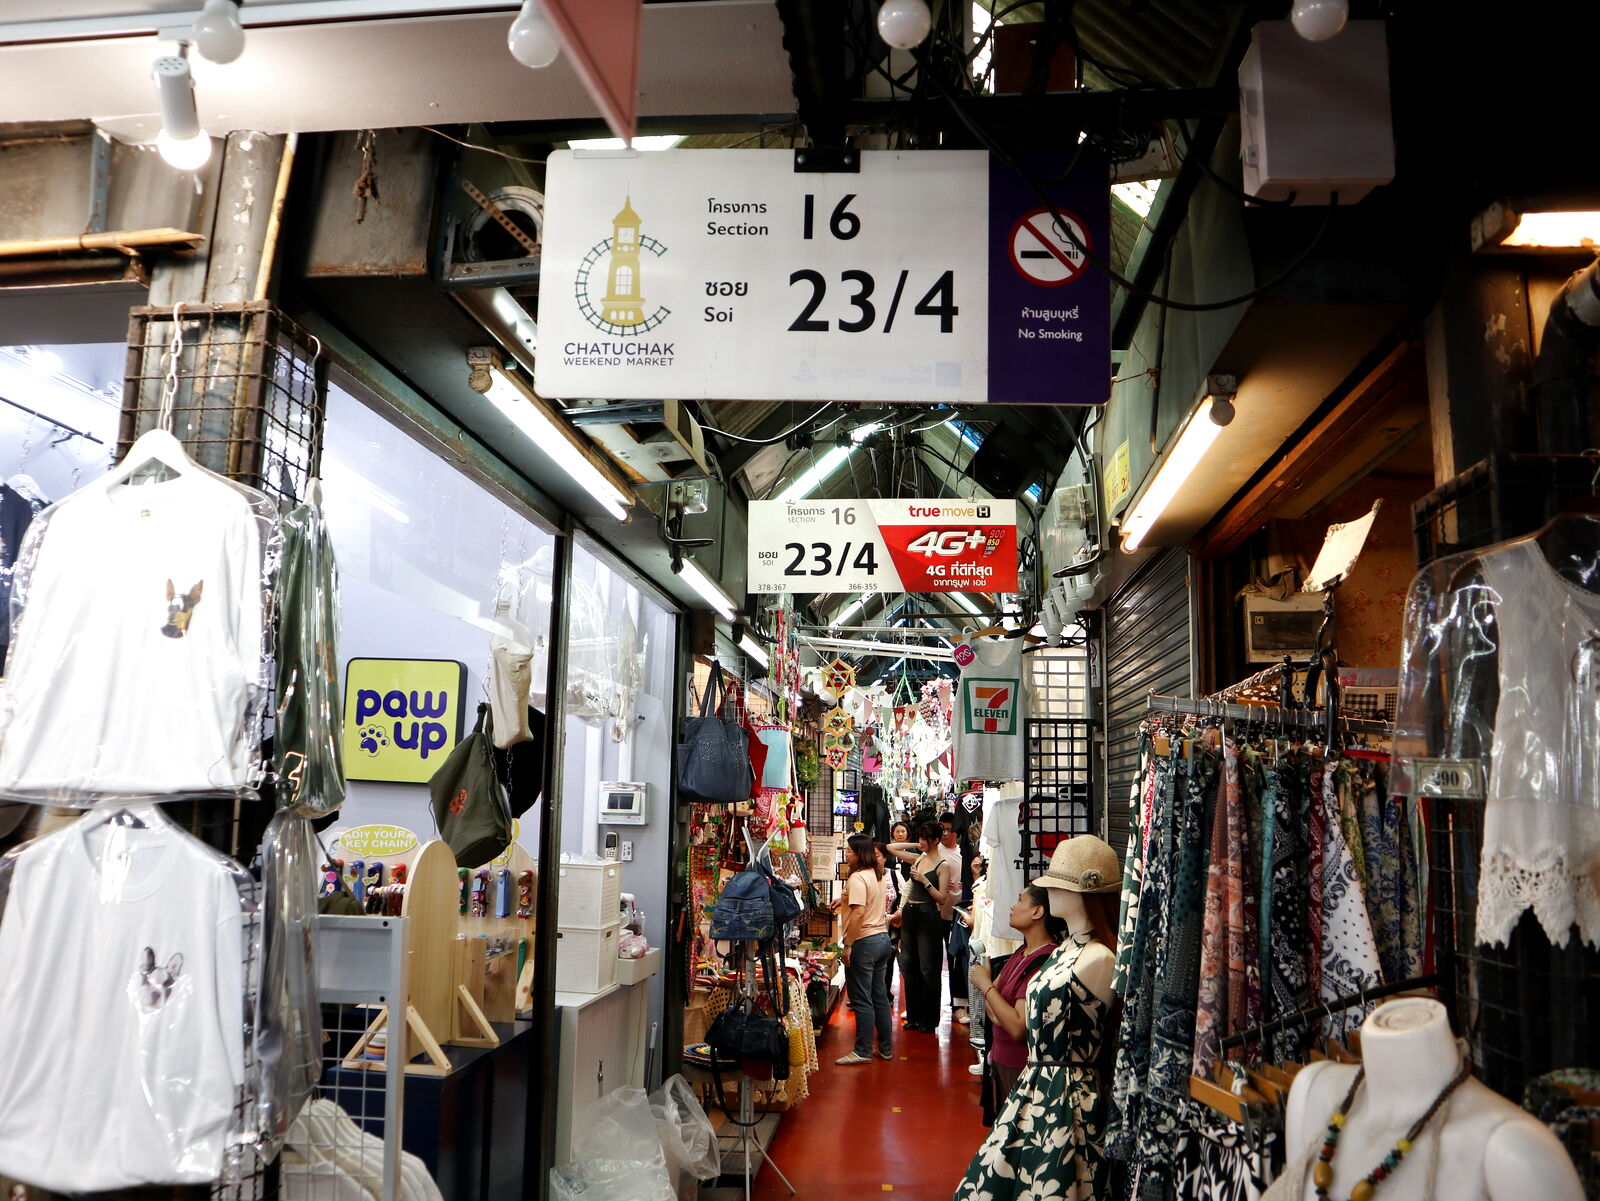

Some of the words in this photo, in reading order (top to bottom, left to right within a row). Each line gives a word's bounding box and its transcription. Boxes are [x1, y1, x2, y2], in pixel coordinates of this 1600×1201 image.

[707, 197, 768, 214] โครงการ
[803, 193, 862, 241] 16
[706, 221, 769, 236] Section
[705, 281, 749, 297] ซอย
[786, 268, 959, 334] 23/4
[703, 306, 734, 323] Soi
[1021, 305, 1080, 322] ห้ามสูบบุหรี่
[1018, 328, 1036, 339] No
[1038, 328, 1083, 342] Smoking
[564, 342, 675, 356] CHATUCHAK
[563, 357, 621, 366] WEEKEND
[626, 357, 675, 366] MARKET
[787, 505, 826, 516] โครงการ
[831, 507, 856, 525] 16
[986, 538, 1001, 546] 850
[989, 529, 1006, 539] 900
[783, 542, 879, 577] 23/4
[926, 564, 946, 576] 4G
[950, 560, 993, 579] ที่ดีที่สุด
[757, 583, 787, 591] 378-367
[355, 689, 448, 726] paw
[393, 721, 448, 760] up
[351, 830, 370, 839] DIY
[373, 830, 405, 839] YOUR
[345, 839, 369, 848] KEY
